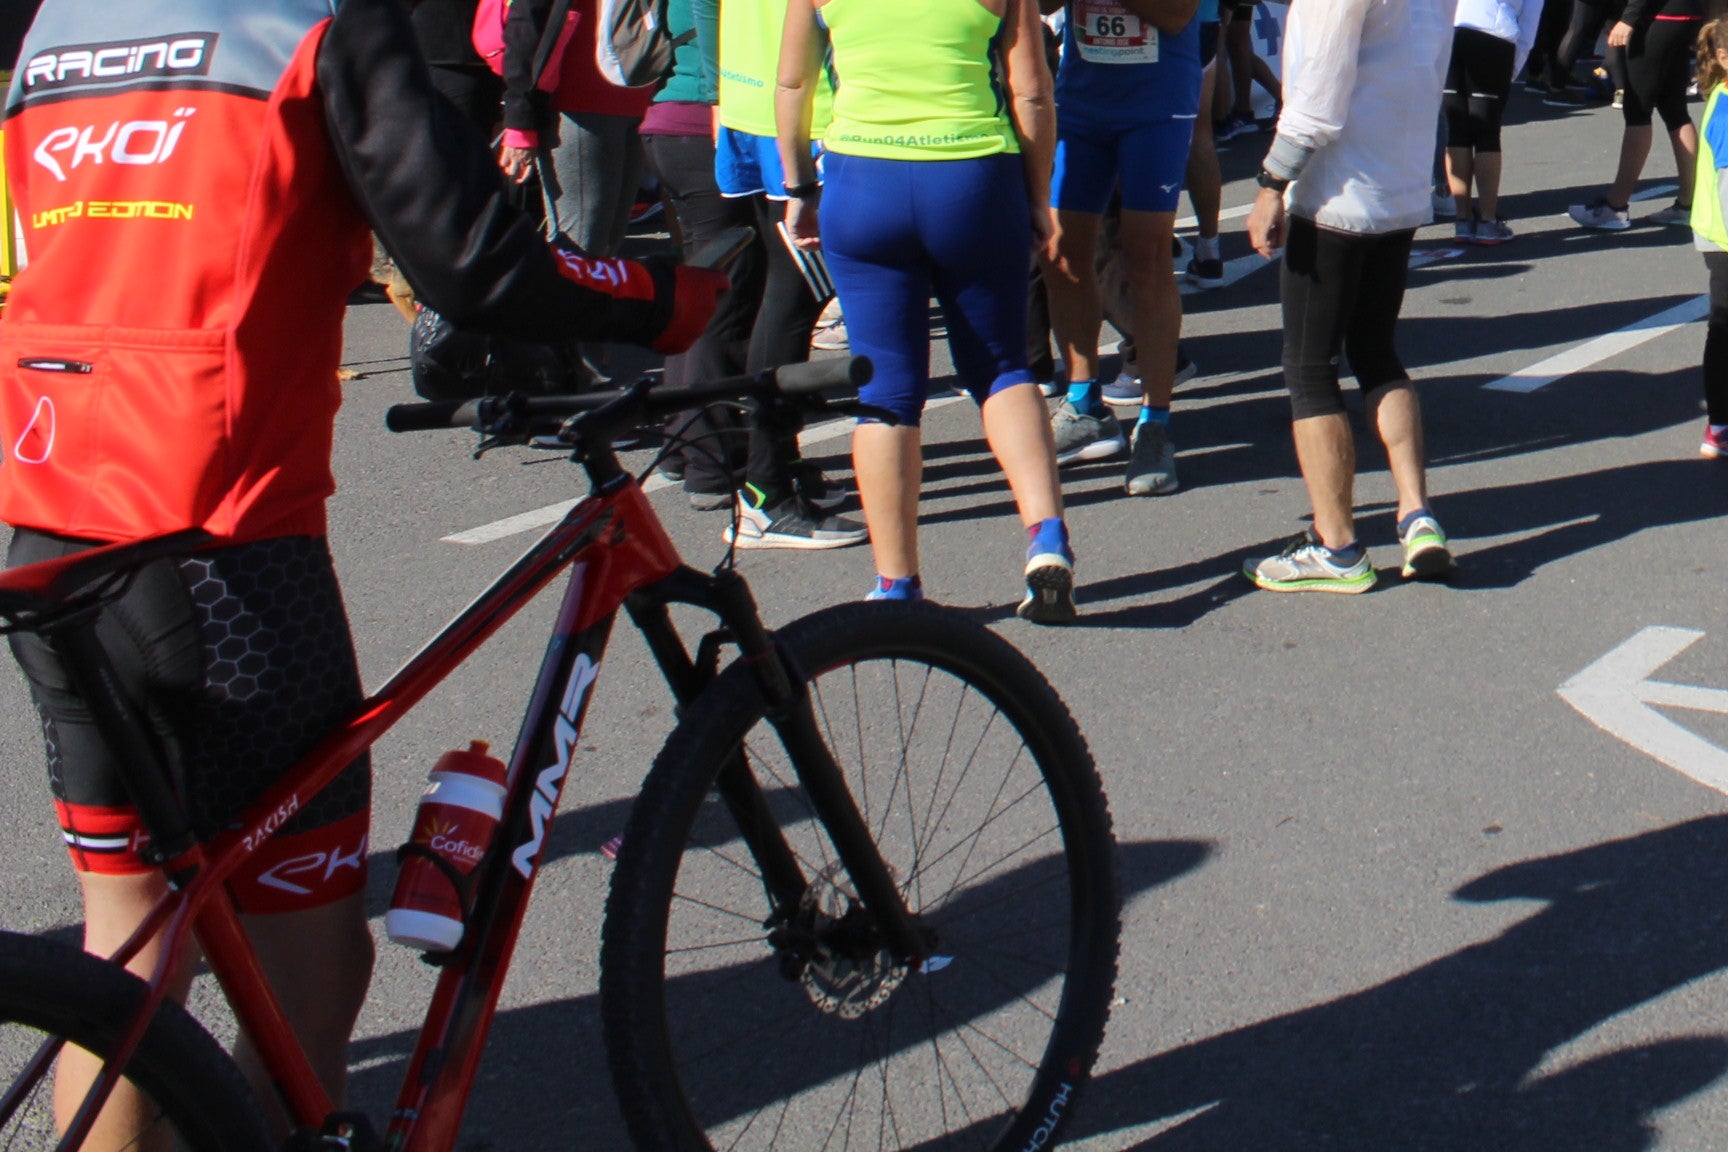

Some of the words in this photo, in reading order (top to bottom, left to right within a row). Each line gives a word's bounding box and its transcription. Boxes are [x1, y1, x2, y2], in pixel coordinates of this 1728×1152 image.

[1097, 15, 1126, 37] 66
[87, 200, 194, 220] EDITION
[511, 652, 601, 881] MMR
